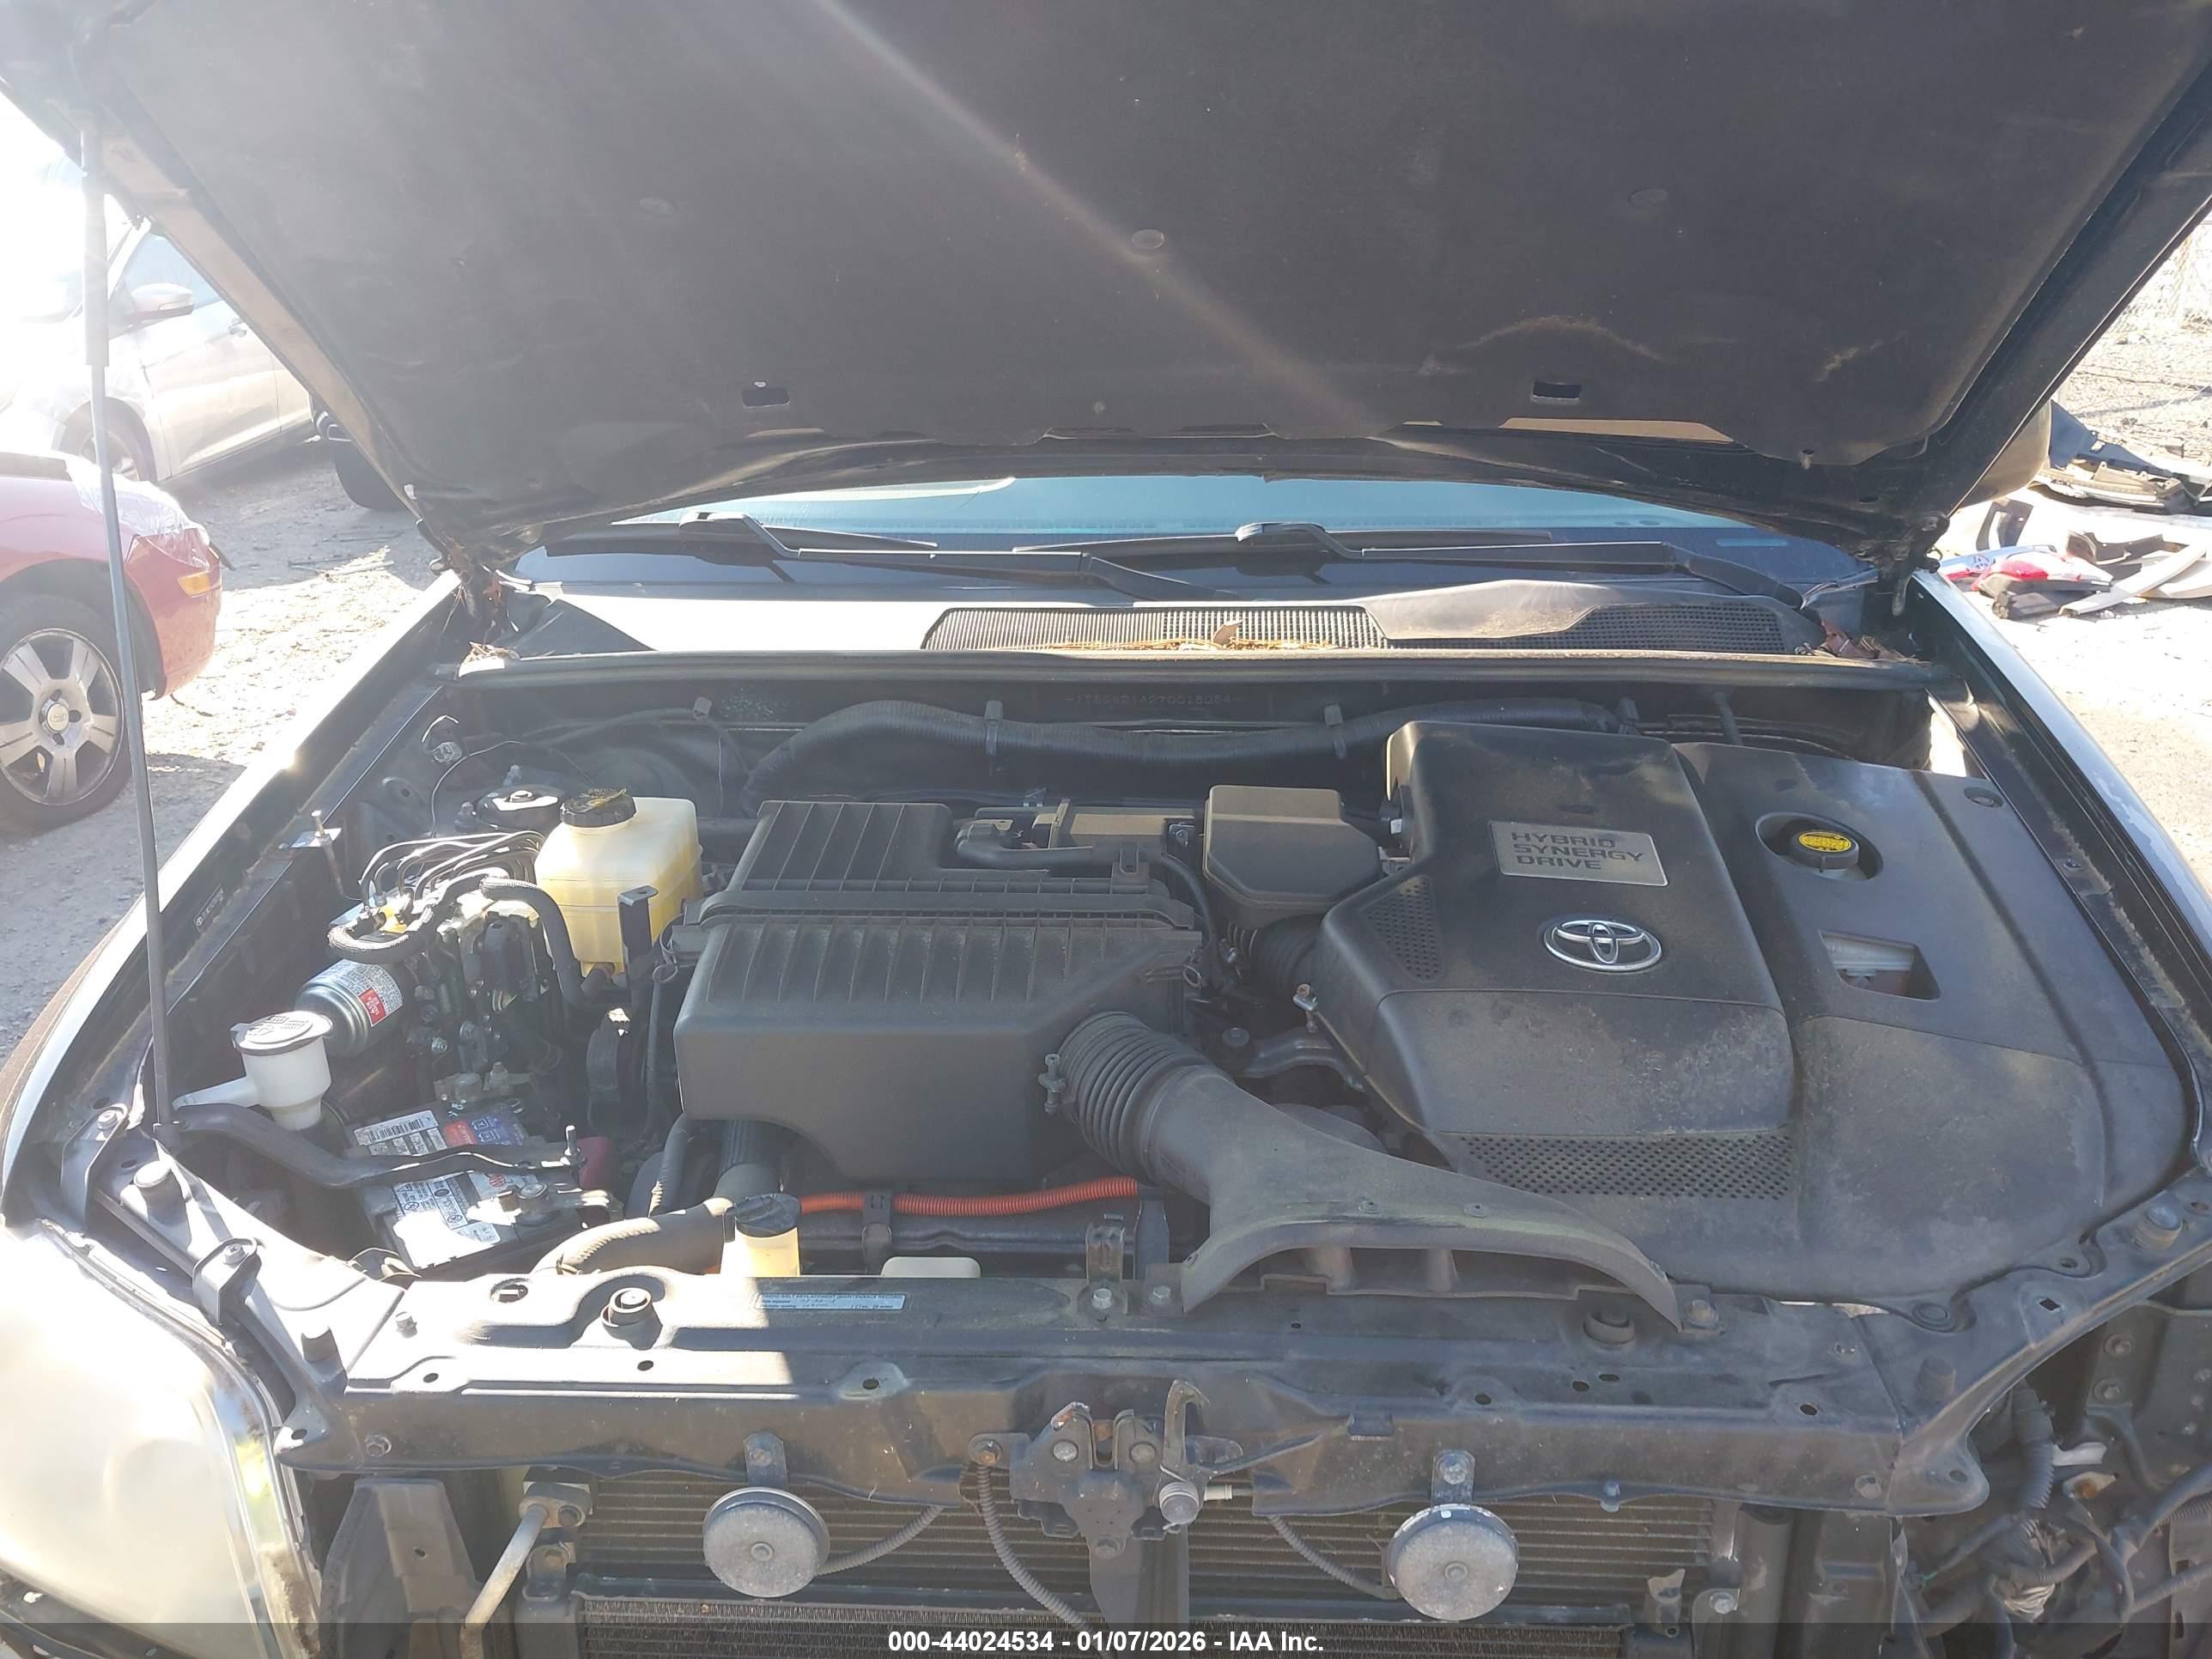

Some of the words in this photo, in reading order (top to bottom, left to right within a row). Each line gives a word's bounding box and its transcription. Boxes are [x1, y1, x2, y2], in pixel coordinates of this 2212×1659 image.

[1511, 831, 1616, 848] HYBRID
[1513, 843, 1644, 862] SYNERGY
[1516, 855, 1602, 870] DRIVE
